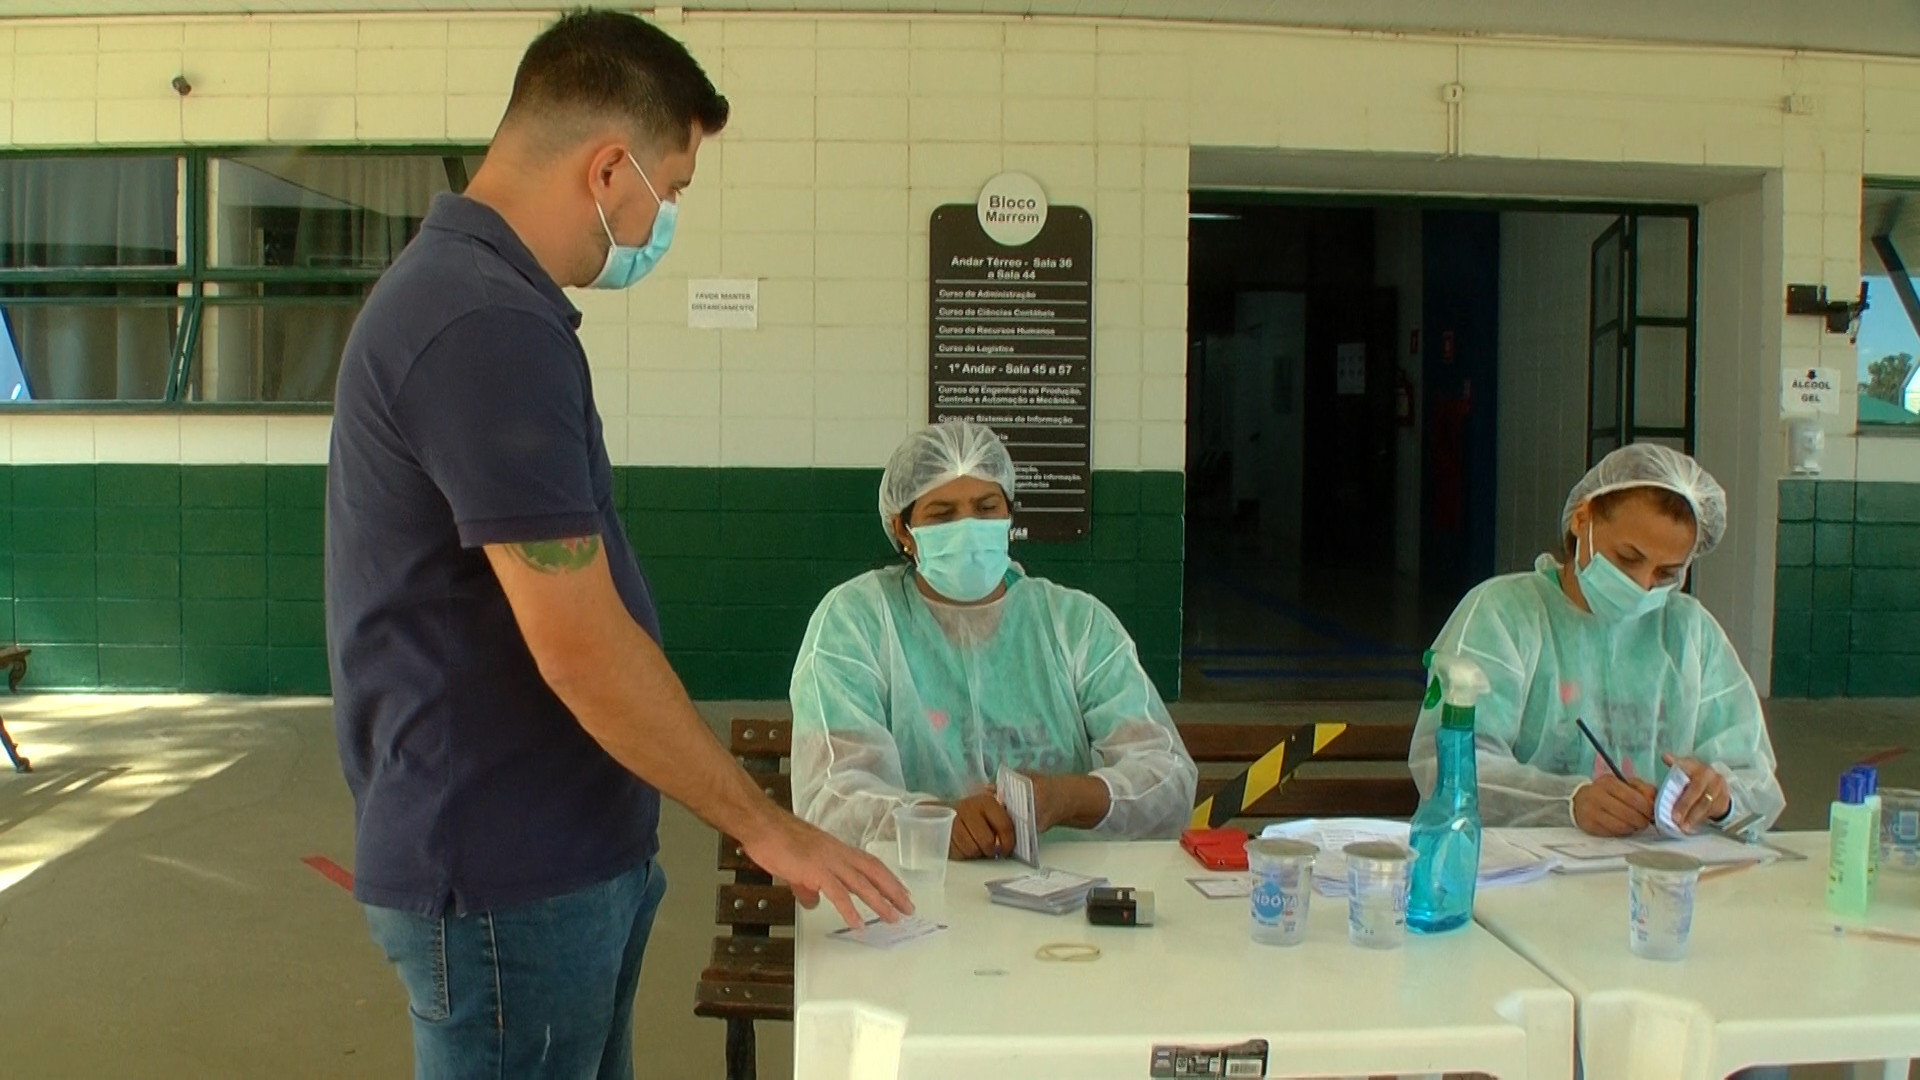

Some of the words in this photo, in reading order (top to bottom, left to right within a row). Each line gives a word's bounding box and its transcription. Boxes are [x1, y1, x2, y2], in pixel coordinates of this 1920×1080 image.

[989, 195, 1036, 210] Bloco
[986, 211, 1039, 223] Marrom
[951, 256, 984, 267] Andar
[987, 256, 1022, 268] Térreo
[1033, 257, 1057, 269] Sala
[1058, 257, 1073, 269] 36
[997, 269, 1021, 280] Sala
[1022, 270, 1036, 280] 44
[938, 288, 964, 298] Curso
[965, 289, 976, 298] de
[977, 289, 1037, 300] Administração
[938, 307, 964, 316] Curso
[965, 308, 976, 316] de
[977, 307, 1013, 316] Ciências
[938, 325, 964, 334] Curso
[965, 326, 976, 334] de
[977, 325, 1016, 335] Recursos
[1017, 327, 1055, 335] Humanos
[938, 343, 964, 352] Curso
[965, 344, 976, 352] de
[977, 344, 1014, 354] Logística
[962, 363, 996, 374] Andar
[1005, 363, 1030, 374] Sala
[1032, 363, 1047, 375] 45
[1792, 378, 1832, 390] ÁLCOOL
[938, 385, 968, 394] Cursos
[969, 386, 980, 394] de
[981, 385, 1028, 396] Engenharia
[1029, 386, 1040, 395] de
[1801, 393, 1821, 402] GEL
[1015, 415, 1026, 423] de
[1027, 415, 1074, 425] Informação
